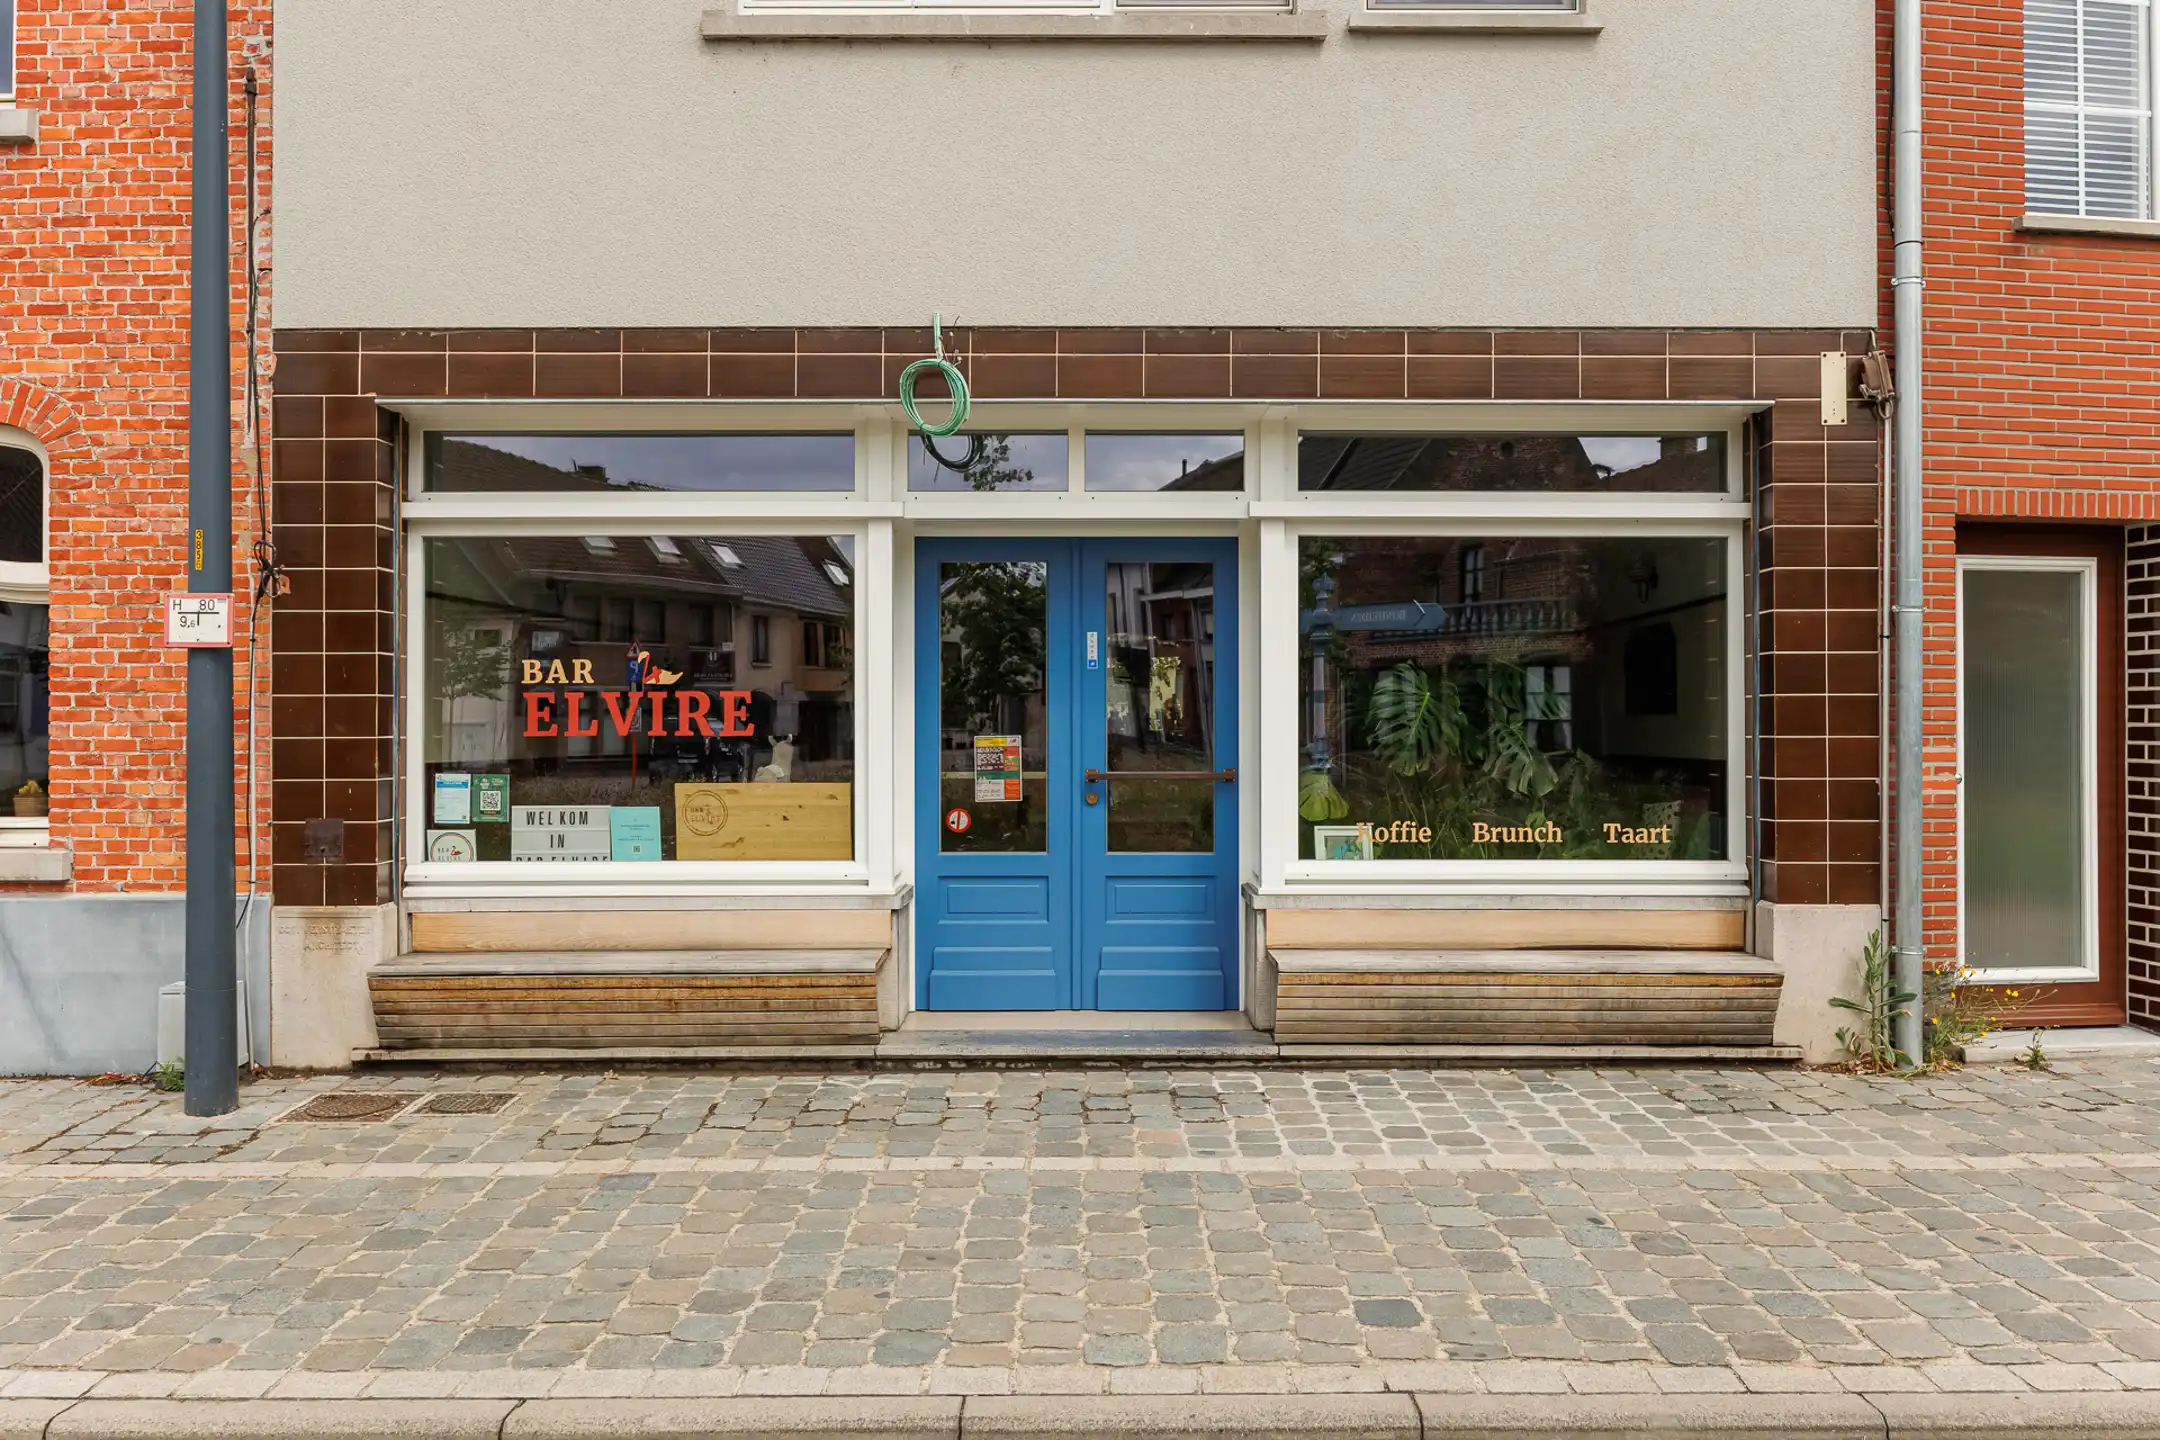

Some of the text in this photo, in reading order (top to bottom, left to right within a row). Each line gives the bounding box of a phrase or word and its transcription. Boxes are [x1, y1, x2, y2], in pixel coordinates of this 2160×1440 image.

[172, 599, 216, 611] H 80
[521, 658, 595, 684] BAR
[523, 691, 755, 737] ELVIRE
[526, 810, 589, 826] WELKOM
[549, 833, 565, 848] IN
[1356, 820, 1671, 844] Koffie Brunch Taart
